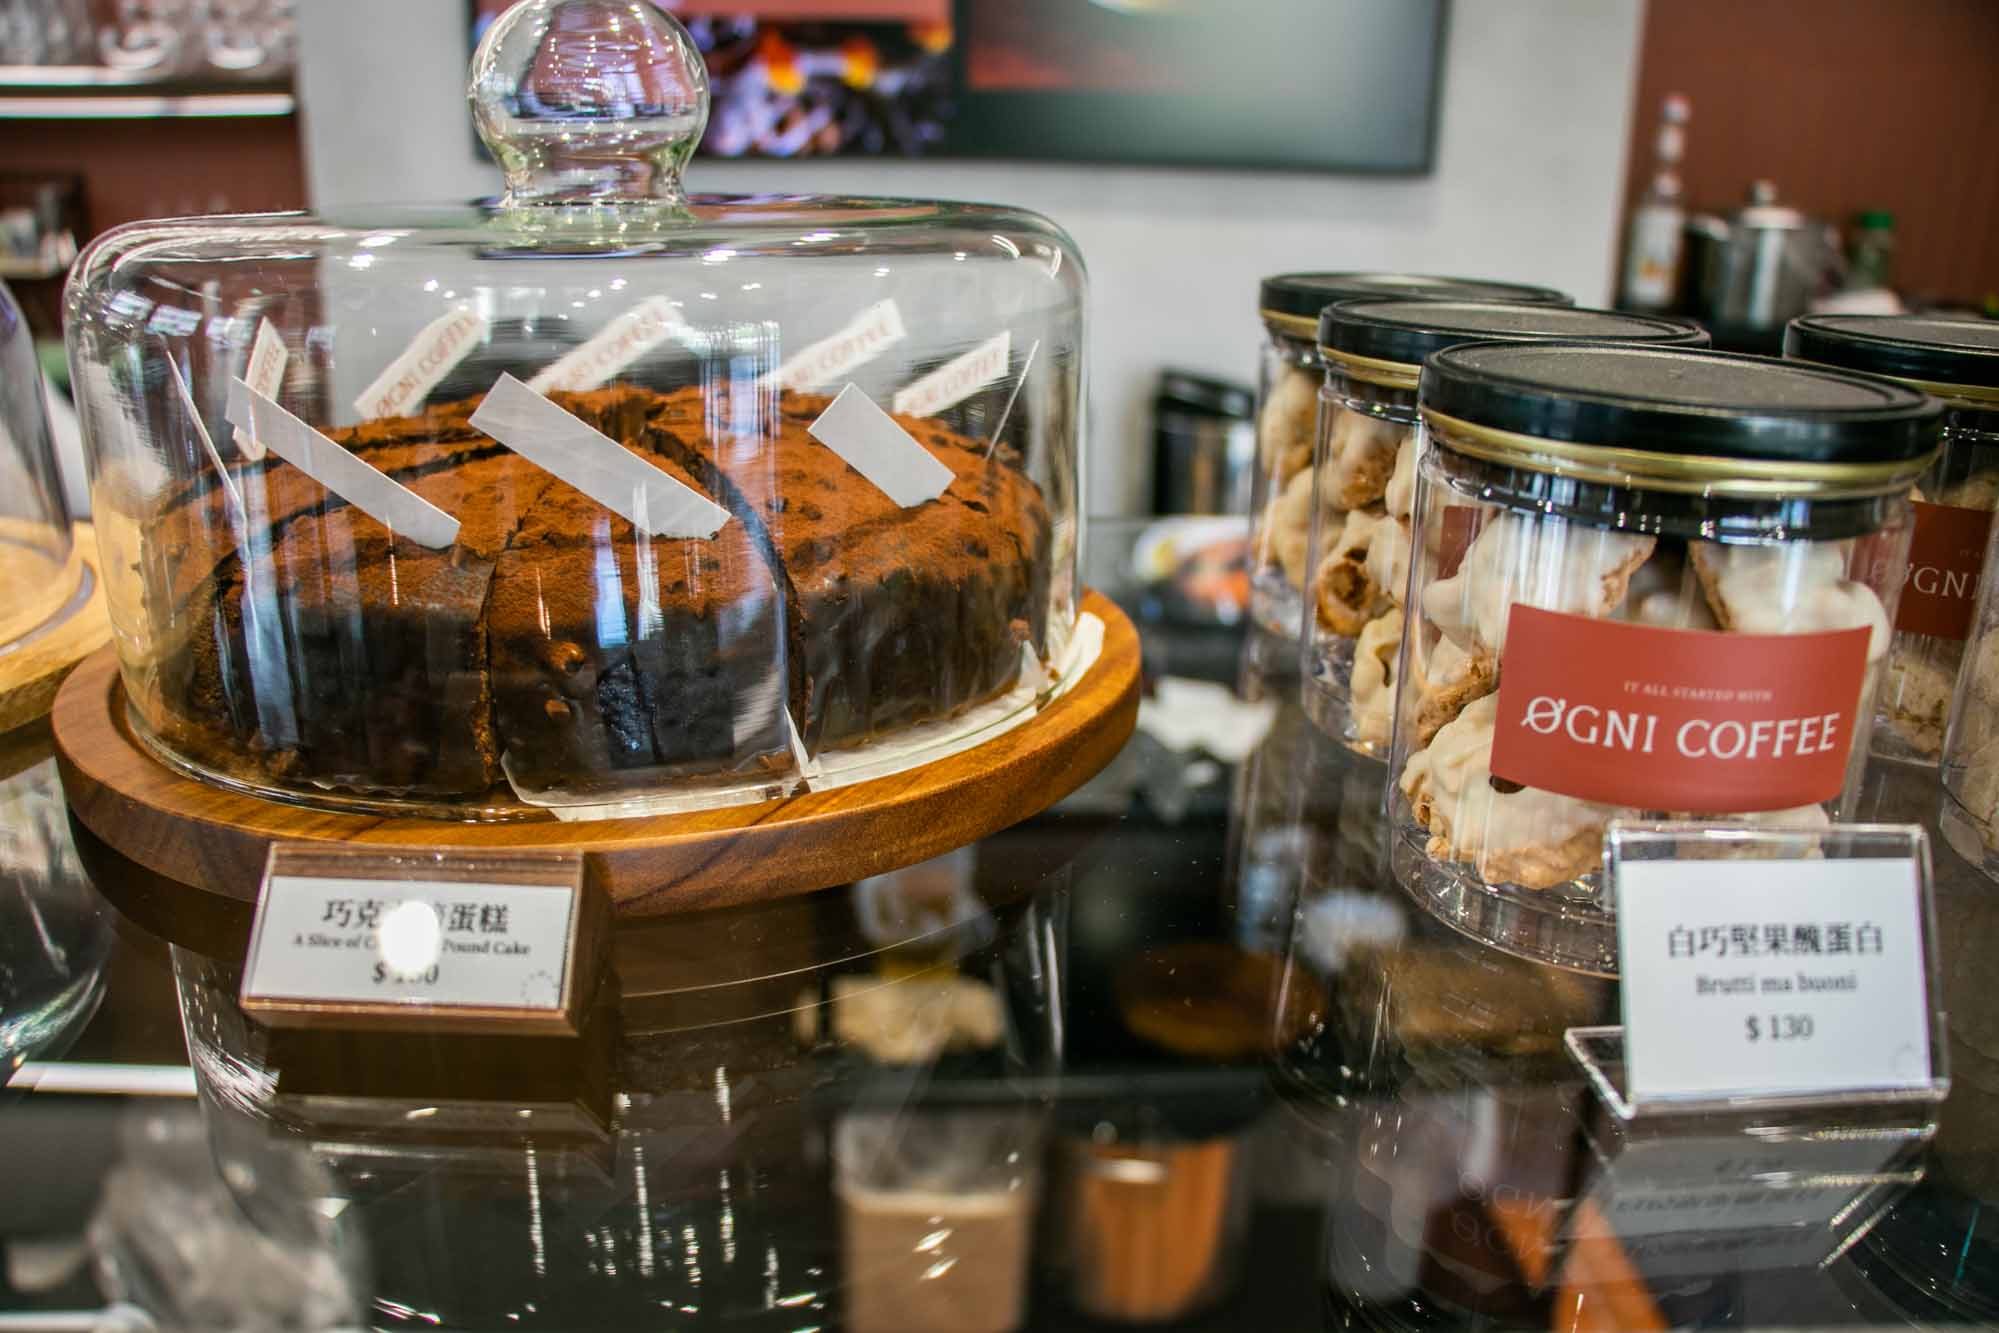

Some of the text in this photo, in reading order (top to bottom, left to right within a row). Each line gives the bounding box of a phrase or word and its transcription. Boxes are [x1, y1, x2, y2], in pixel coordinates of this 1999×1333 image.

[1677, 713, 1839, 760] COFFEE
[323, 899, 508, 934] 巧克蛋糕
[308, 932, 343, 948] Slice
[346, 933, 363, 949] of
[494, 941, 531, 956] Cake
[1695, 971, 1857, 995] Brutti ma buoni
[1770, 1013, 1815, 1041] 130
